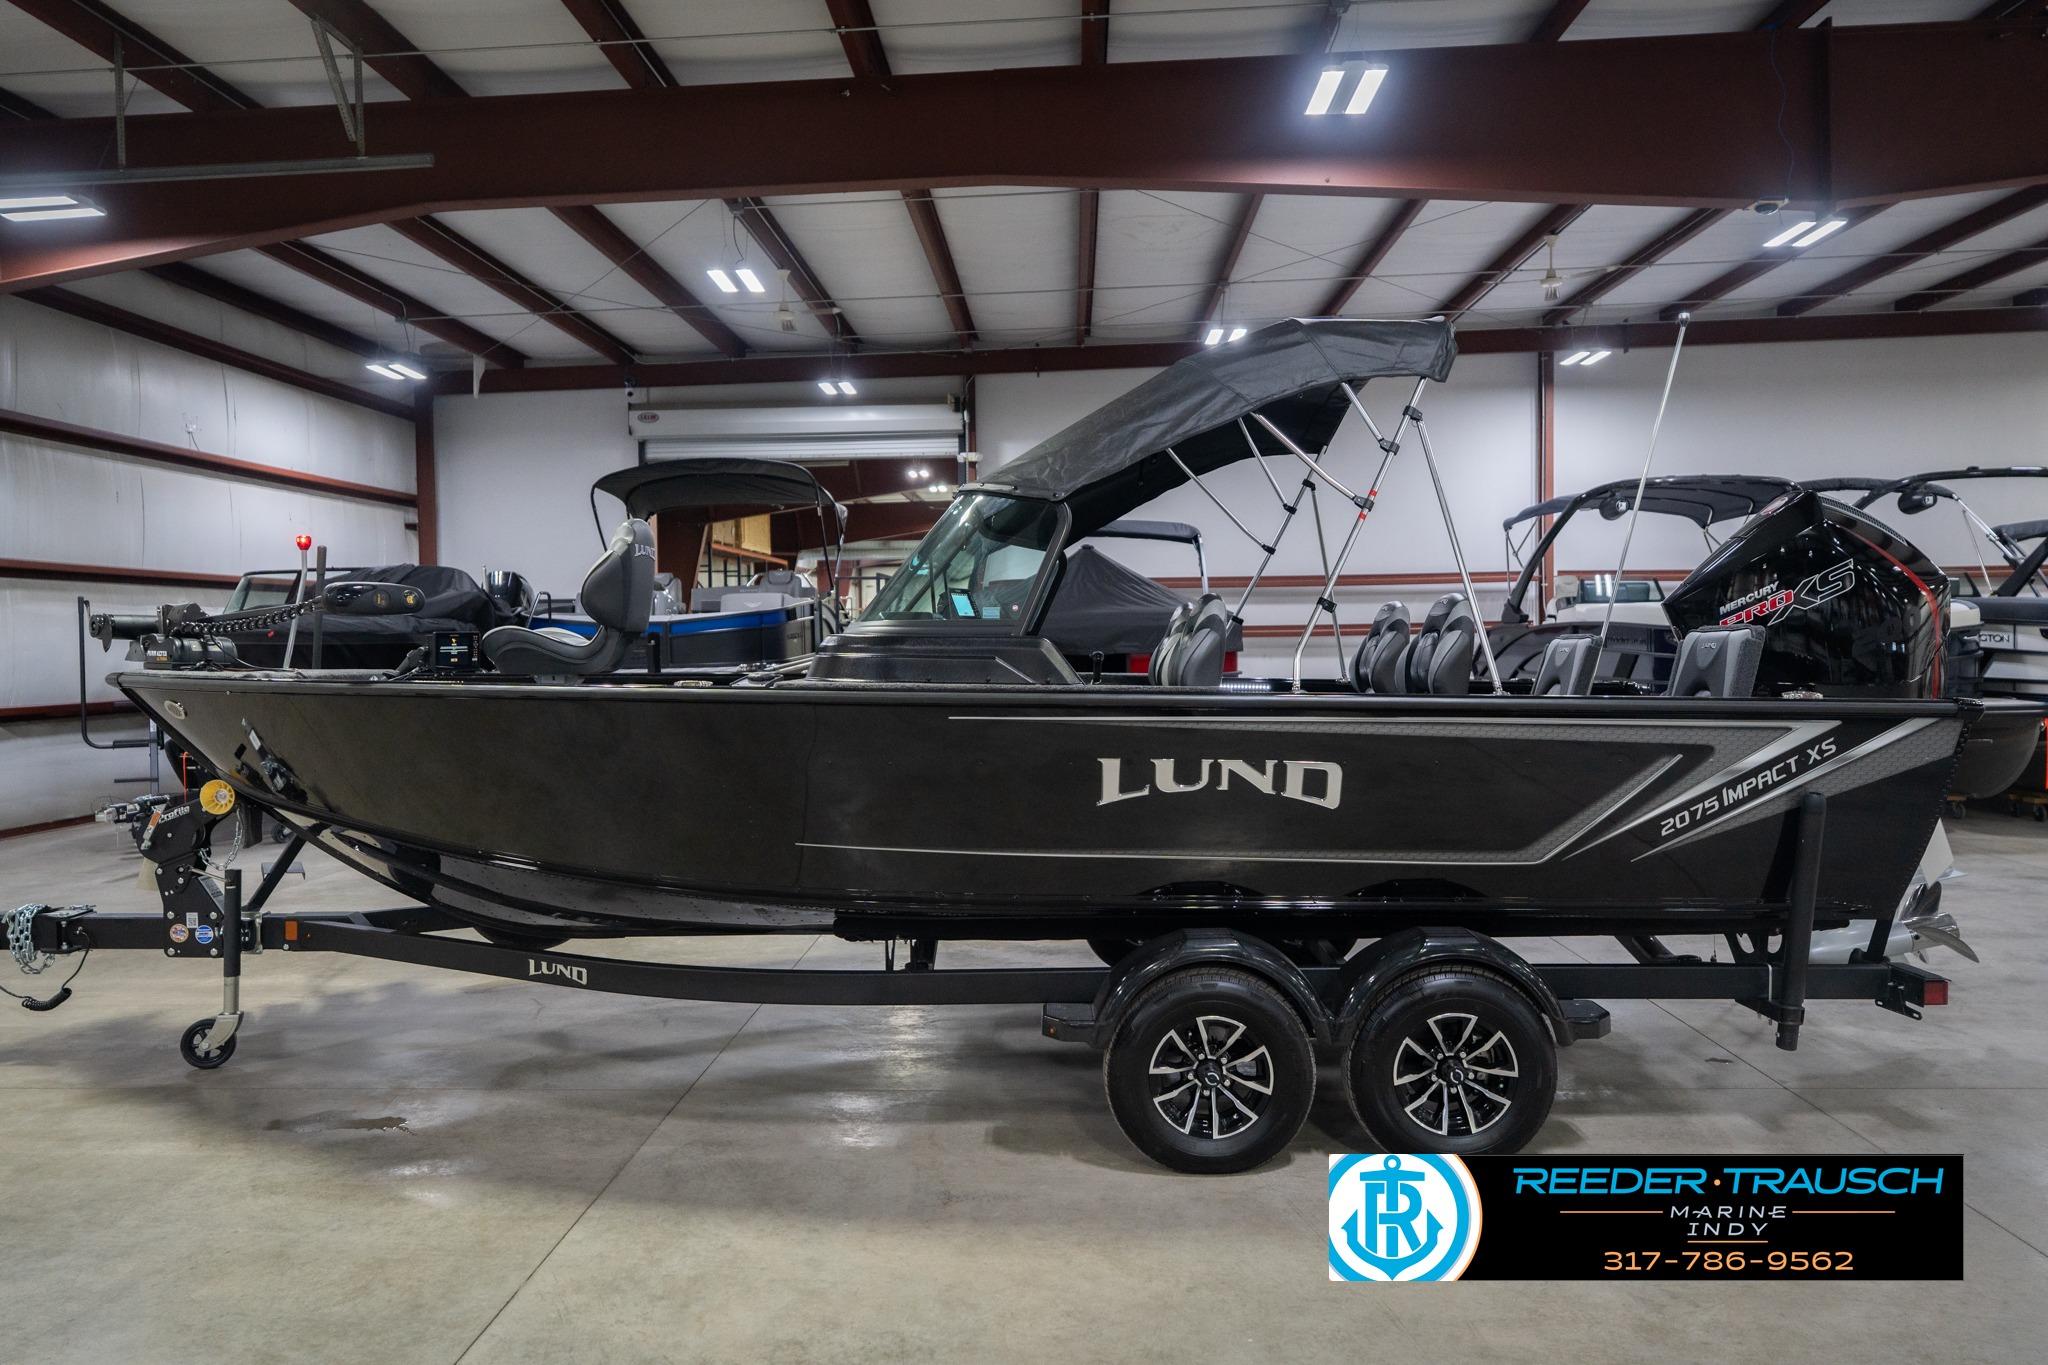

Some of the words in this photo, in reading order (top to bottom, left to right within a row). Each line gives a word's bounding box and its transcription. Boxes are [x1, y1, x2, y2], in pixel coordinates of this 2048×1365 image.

[1719, 581, 1780, 615] MERCURY
[1767, 558, 1856, 627] XS
[1096, 758, 1343, 810] LUND
[1660, 795, 1720, 837] 2075
[1722, 755, 1799, 807] IMPACT
[1806, 737, 1837, 765] XS
[528, 959, 588, 986] LUND
